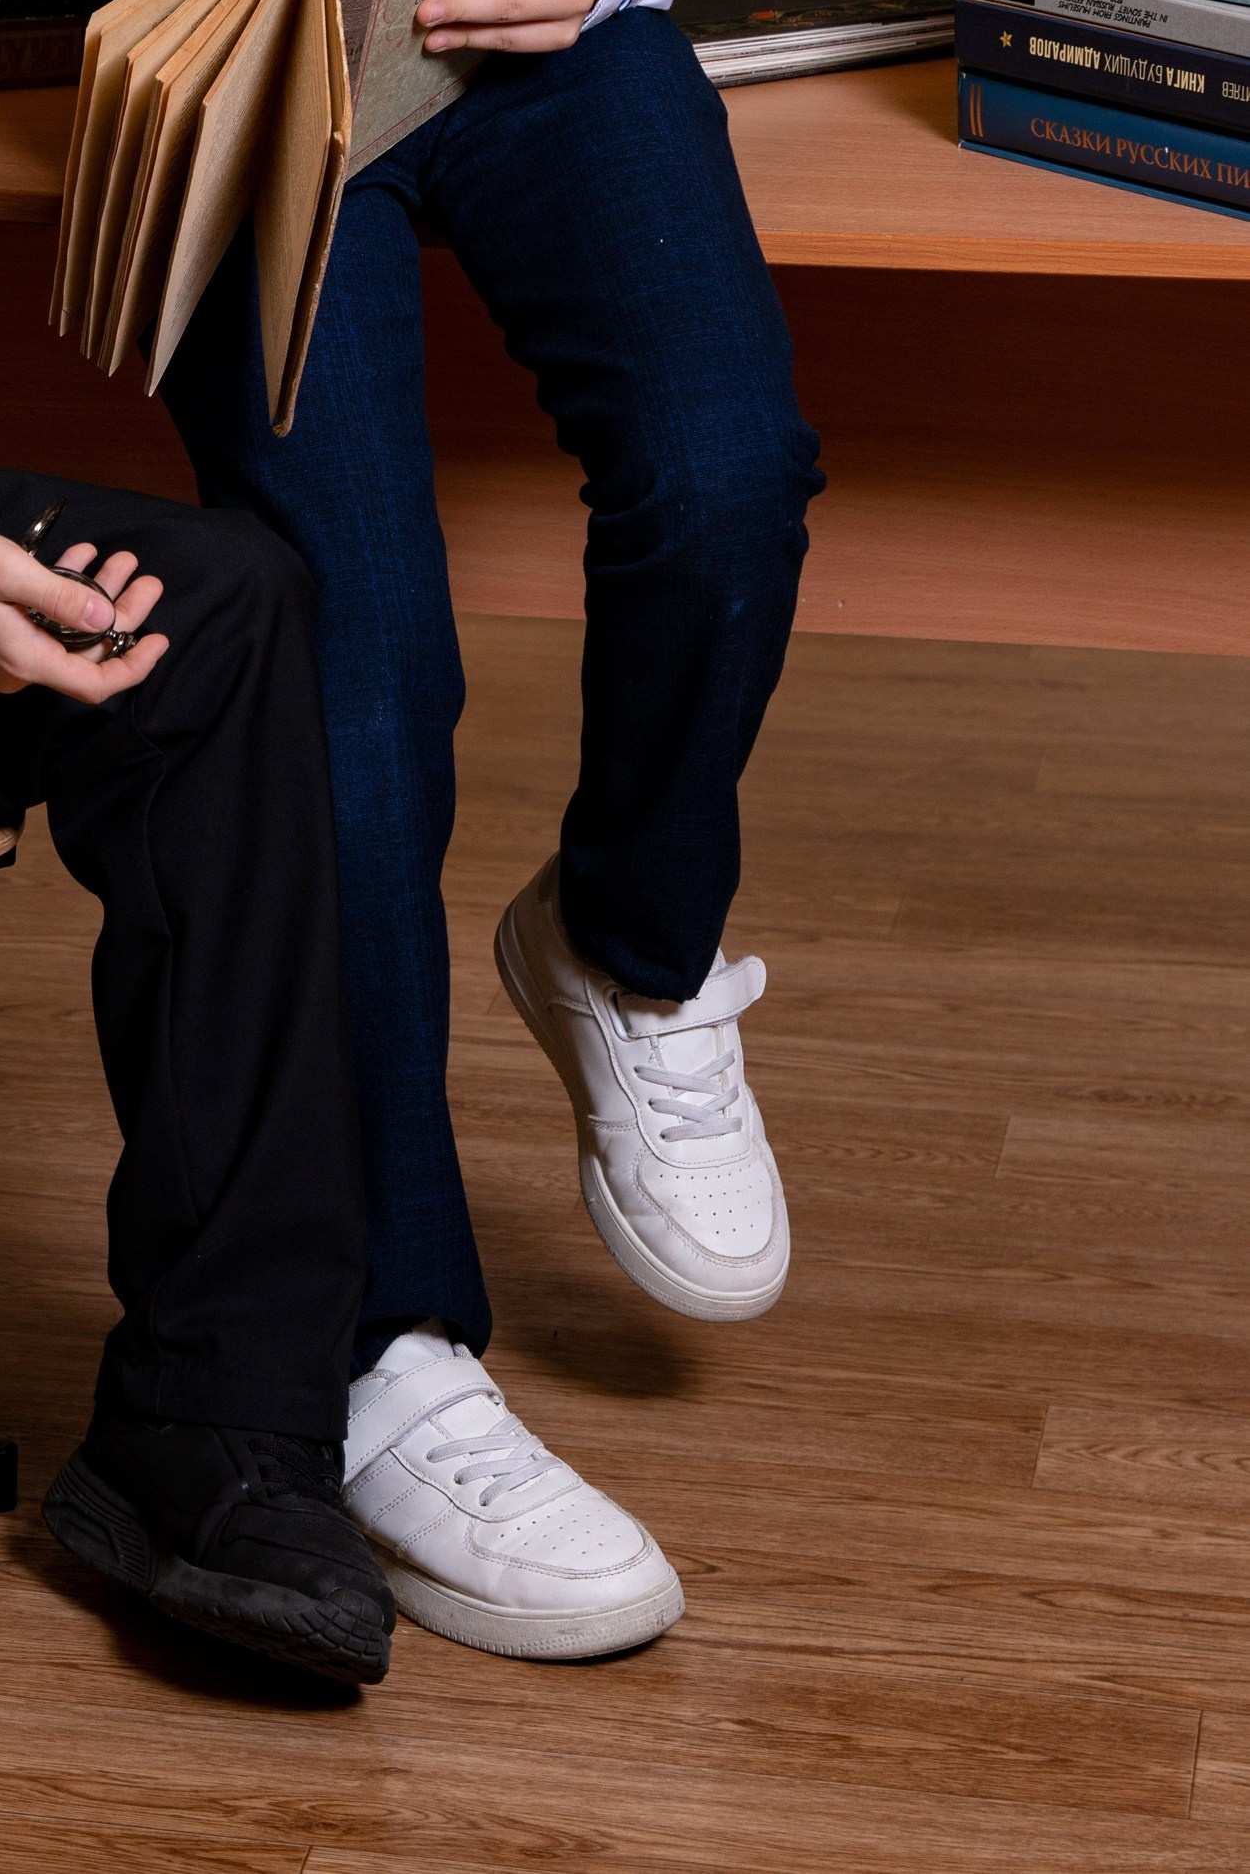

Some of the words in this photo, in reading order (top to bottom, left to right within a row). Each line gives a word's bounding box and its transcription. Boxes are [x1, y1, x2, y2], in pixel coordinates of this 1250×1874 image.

[1057, 0, 1092, 16] MUSEUMS
[1085, 0, 1116, 12] RUSSIAN
[1117, 5, 1143, 17] SOVIET
[1092, 9, 1113, 20] FROM
[1114, 12, 1152, 28] PAINTINGS
[1143, 10, 1159, 22] THE
[1159, 14, 1169, 24] IN
[1029, 35, 1101, 70] АДМИРАЛОВ
[1103, 53, 1163, 84] БУДУЩИХ
[1165, 66, 1206, 95] КНИГА
[1029, 116, 1112, 155] СКАЗКИ
[1115, 137, 1213, 181] РУССКИХ
